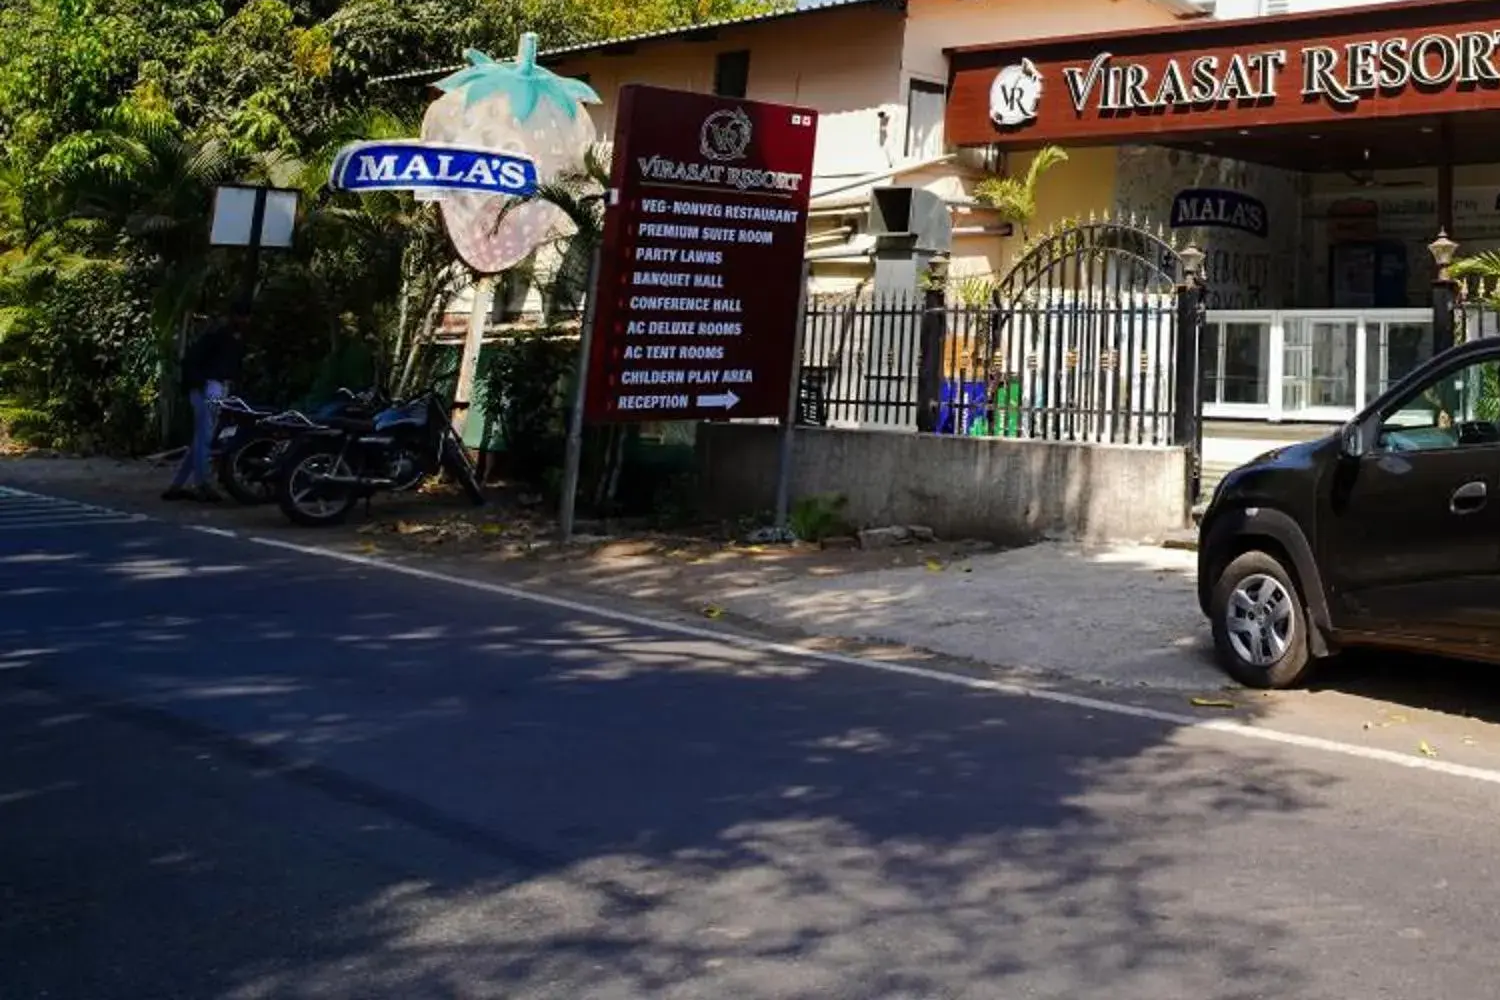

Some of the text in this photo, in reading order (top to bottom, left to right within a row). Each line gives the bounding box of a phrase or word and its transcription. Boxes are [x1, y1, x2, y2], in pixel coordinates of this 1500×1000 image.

[1063, 52, 1287, 112] VIRASAT
[356, 155, 526, 189] MALA'S
[637, 155, 803, 193] VIRASAT RESORT
[725, 205, 798, 223] RESTAURANT
[1177, 197, 1263, 231] MALA'S
[638, 223, 773, 244] PREMIUM SUITE ROOM
[635, 247, 723, 265] PARTY LAWNS
[632, 272, 724, 288] BANQUET HALL
[629, 296, 743, 312] CONFERENCE HALL
[627, 321, 742, 335] AC DELUXE ROOMS
[624, 346, 724, 359] AC TENT ROOMS
[687, 370, 721, 383] PLAY
[722, 369, 753, 383] AREA
[618, 395, 689, 409] RECEPTION
